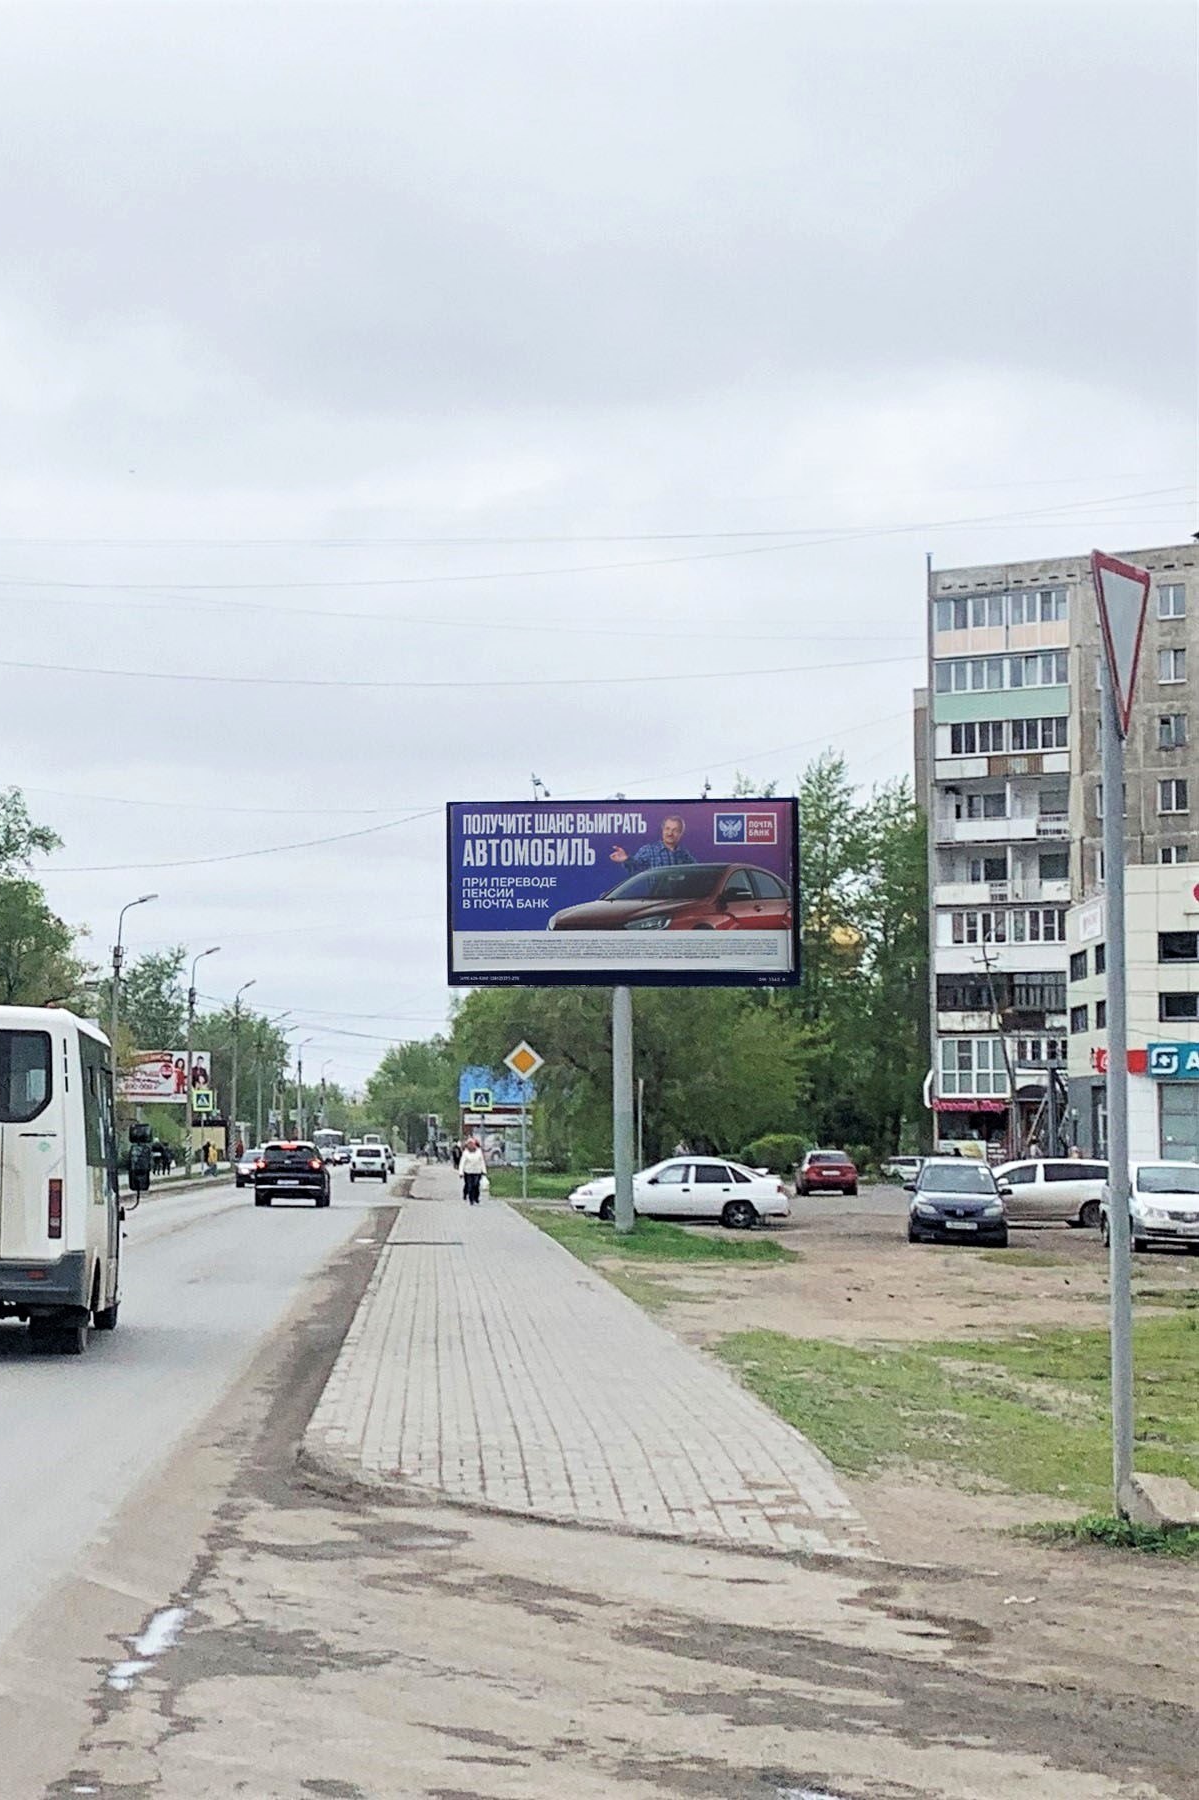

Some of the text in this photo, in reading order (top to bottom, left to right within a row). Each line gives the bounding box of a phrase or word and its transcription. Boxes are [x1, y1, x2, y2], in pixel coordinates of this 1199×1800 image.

[462, 812, 647, 835] ПОЛУЧИТЕ ШАНС ВЫИГРАТЬ
[748, 828, 770, 837] БАНК
[462, 838, 596, 867] АВТОМОБИЛЬ
[462, 876, 557, 888] ПРИ ПЕРЕВОДЕ
[462, 888, 514, 898] ПЕНСИИ
[462, 897, 550, 909] В ПОЧТА БАНК
